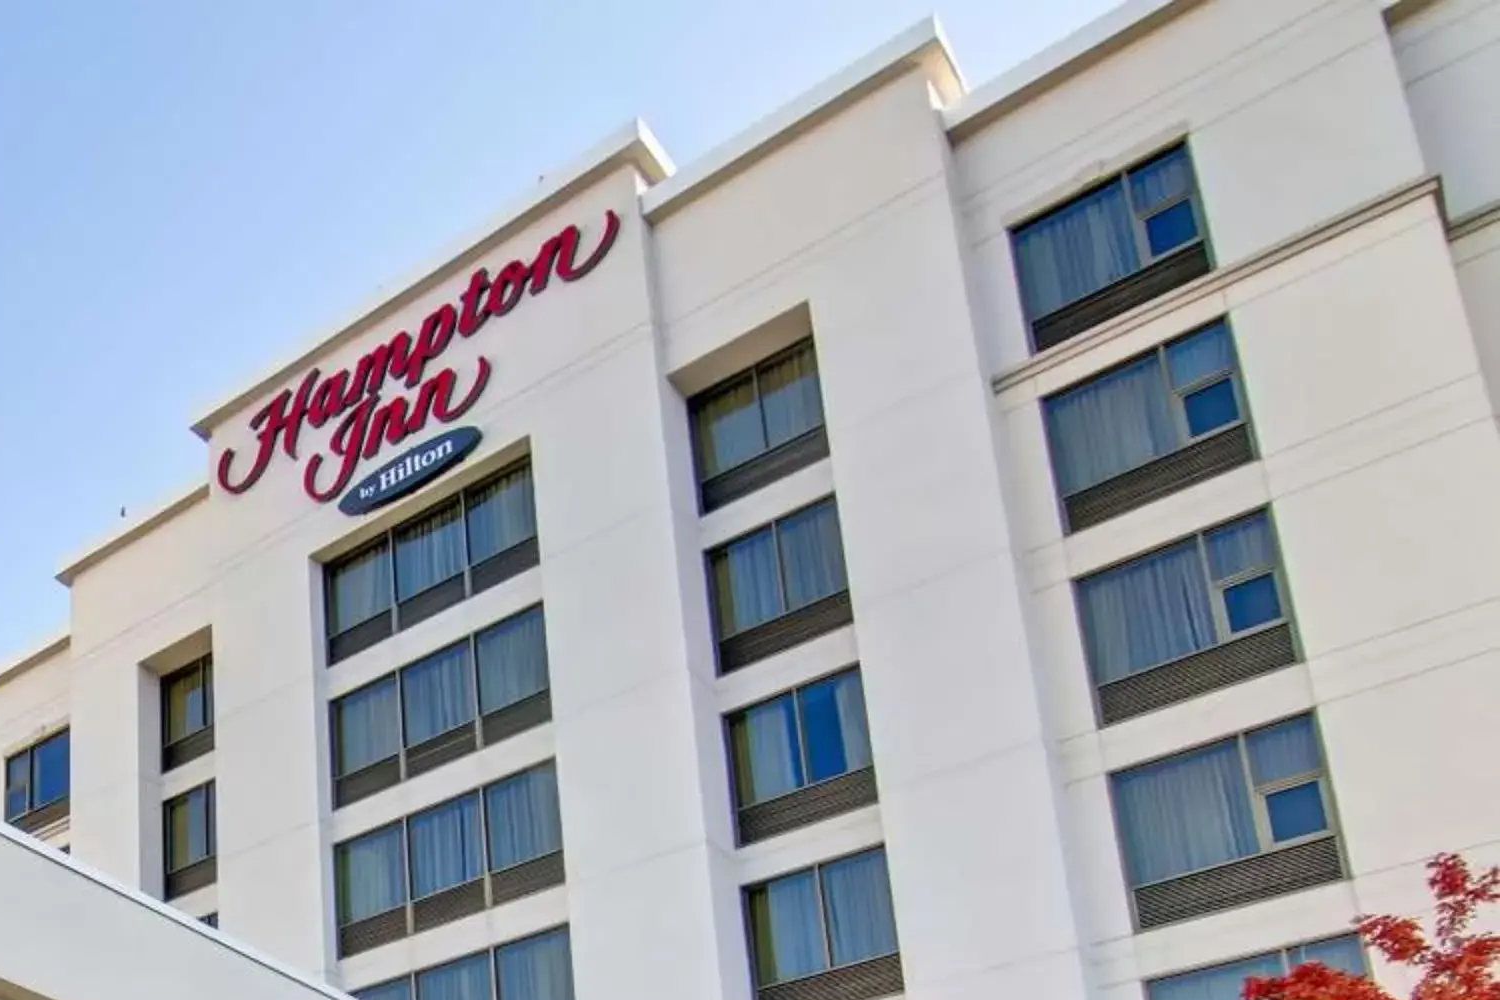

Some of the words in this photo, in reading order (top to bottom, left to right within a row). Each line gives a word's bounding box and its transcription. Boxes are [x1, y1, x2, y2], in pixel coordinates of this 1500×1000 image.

[218, 209, 620, 494] Hampton
[304, 356, 491, 502] Inn
[359, 485, 377, 499] by
[379, 439, 453, 492] Hilton
